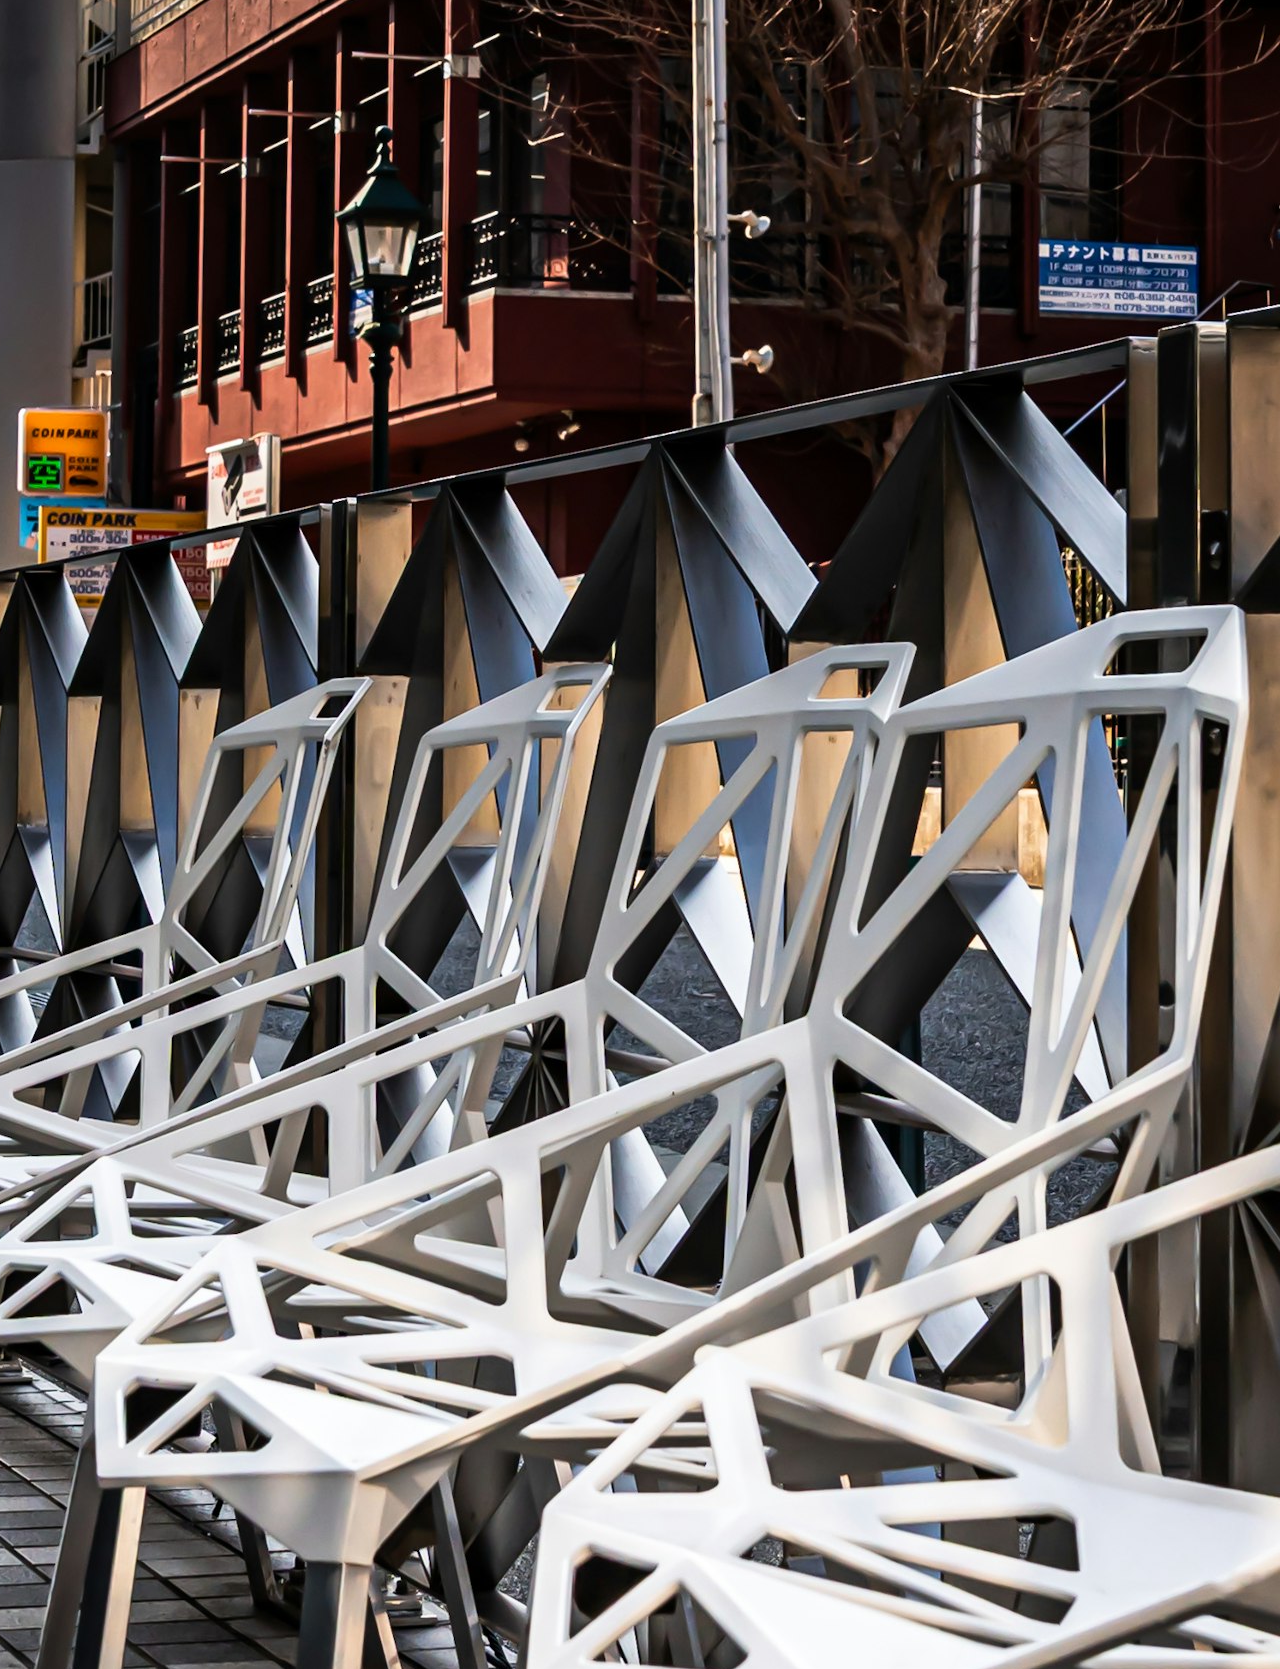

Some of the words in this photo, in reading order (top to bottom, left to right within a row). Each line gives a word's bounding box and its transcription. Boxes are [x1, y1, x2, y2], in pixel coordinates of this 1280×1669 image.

[31, 428, 65, 438] COIN
[66, 428, 99, 439] PARK
[28, 455, 61, 489] 空
[47, 512, 87, 527] COIN
[91, 513, 137, 527] PARK
